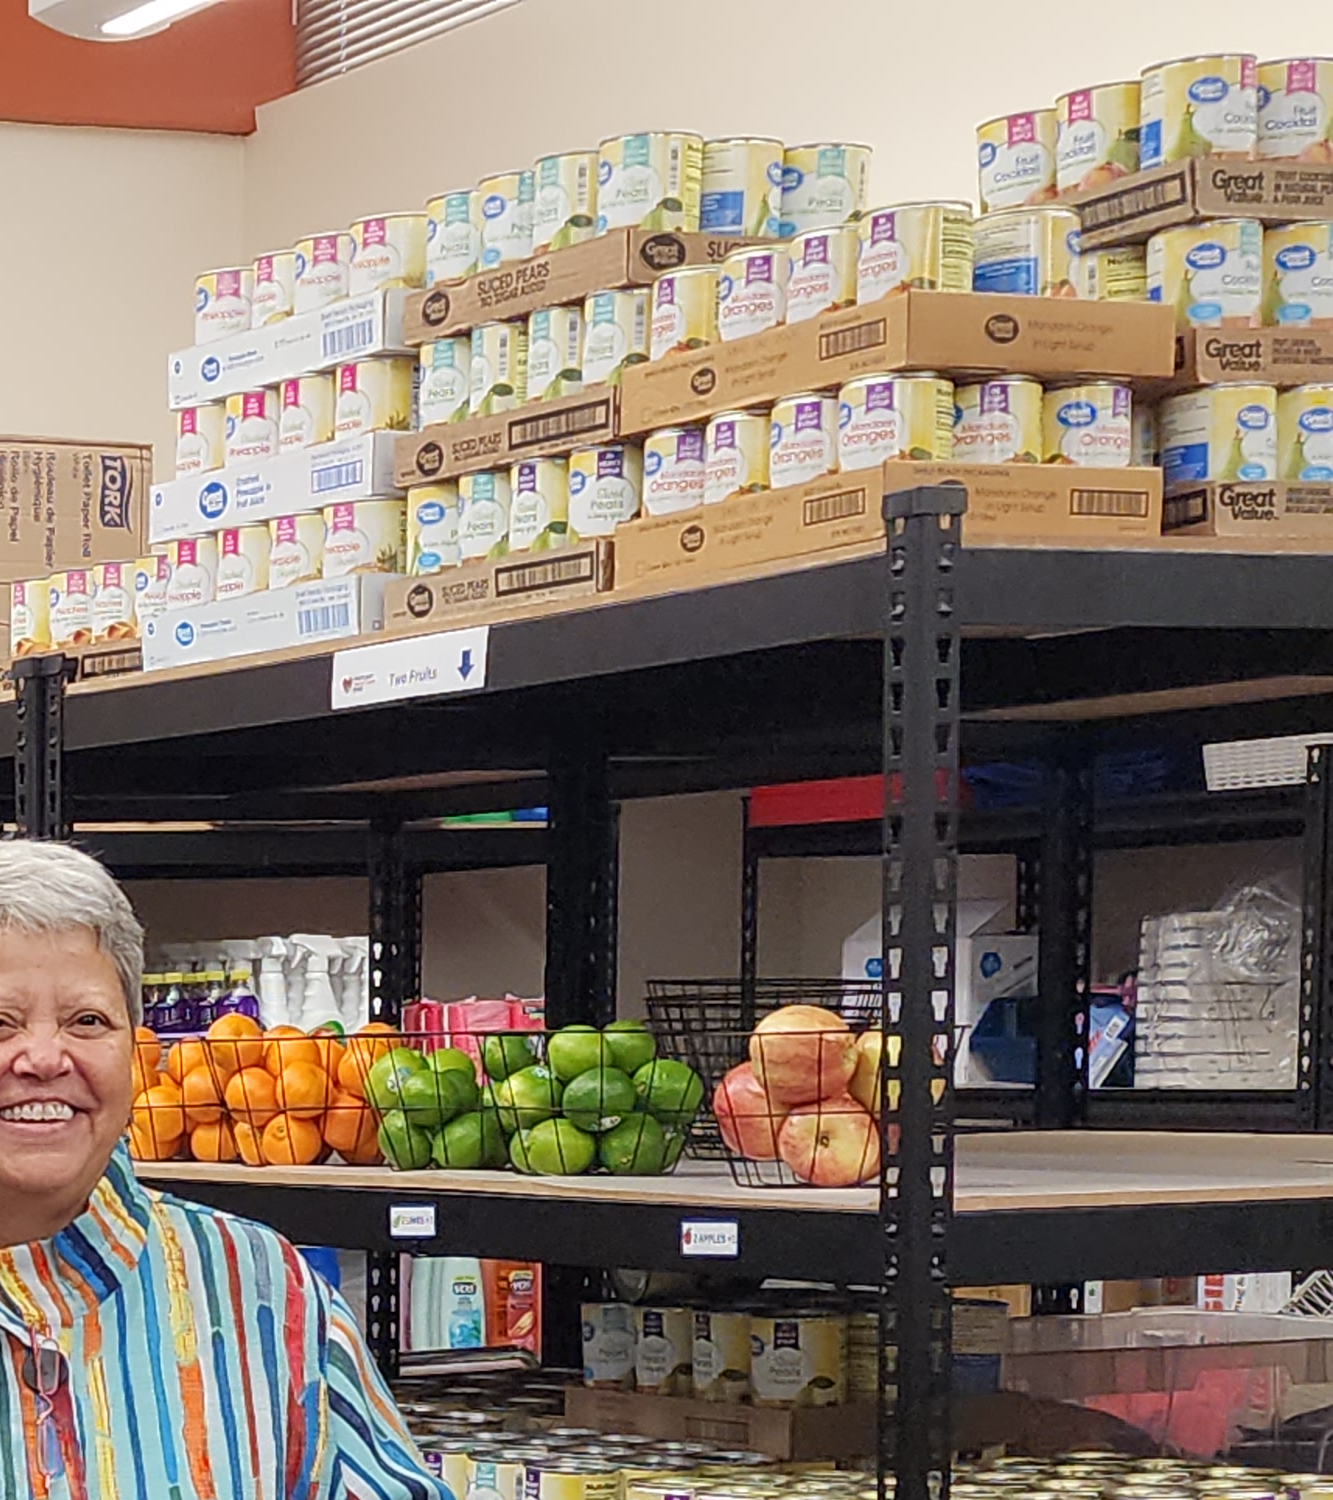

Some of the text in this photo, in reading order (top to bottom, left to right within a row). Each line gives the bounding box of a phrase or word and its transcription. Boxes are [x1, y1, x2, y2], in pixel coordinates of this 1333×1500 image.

[1058, 141, 1097, 163] ocktail
[1211, 169, 1265, 193] Great
[1205, 338, 1263, 360] Great
[102, 457, 122, 526] TORK
[1219, 486, 1276, 510] Great
